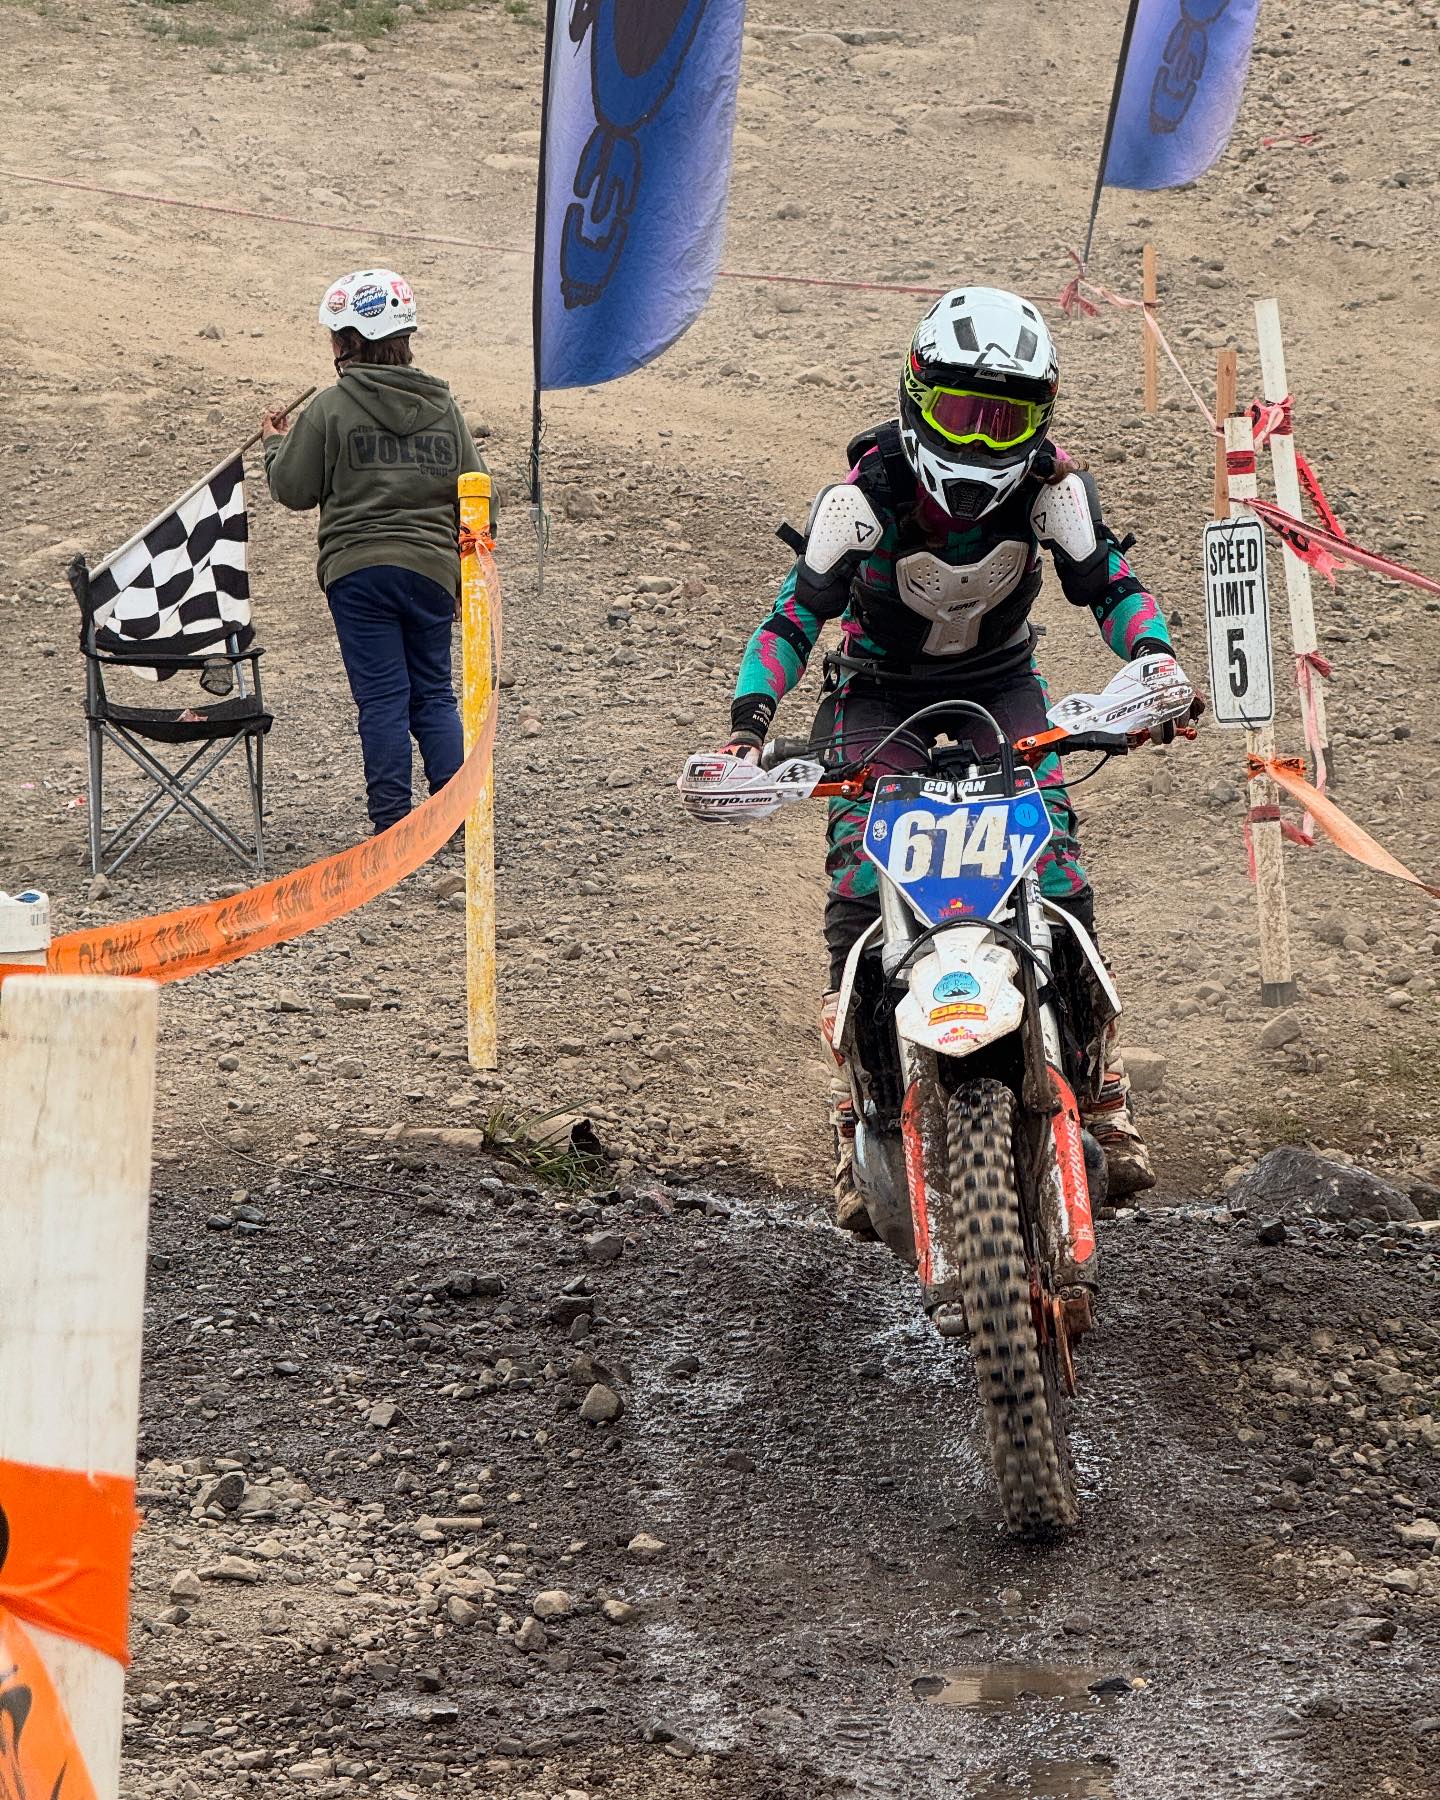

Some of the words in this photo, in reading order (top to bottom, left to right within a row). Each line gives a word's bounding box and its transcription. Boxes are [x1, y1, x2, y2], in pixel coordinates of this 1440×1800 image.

[354, 434, 453, 465] VOLKS
[420, 464, 449, 478] Group
[1209, 538, 1258, 577] SPEED
[1212, 579, 1256, 618] LIMIT
[1226, 627, 1249, 698] 5
[887, 804, 1009, 884] 614
